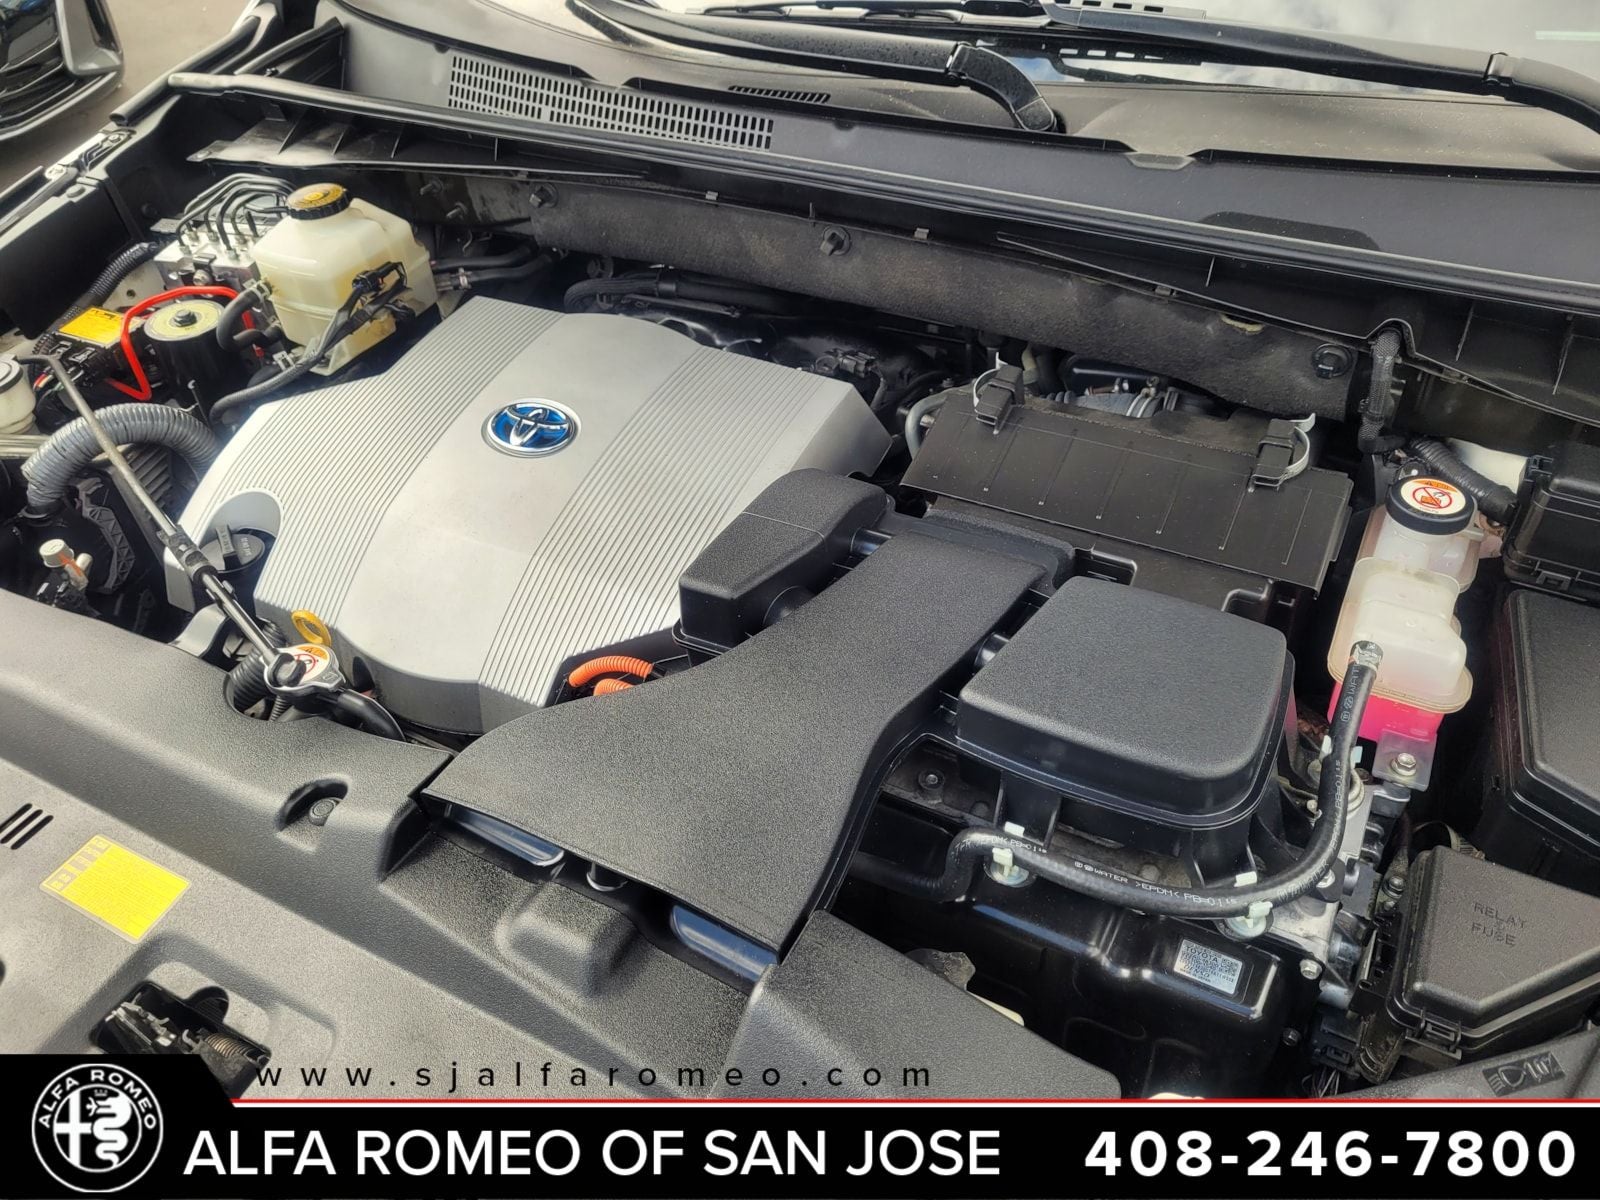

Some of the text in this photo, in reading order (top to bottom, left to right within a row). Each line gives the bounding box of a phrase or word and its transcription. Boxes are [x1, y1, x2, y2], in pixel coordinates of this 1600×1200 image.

[1094, 868, 1128, 883] WATER
[1474, 902, 1527, 929] RELAY
[1472, 922, 1516, 946] FUSE
[1185, 945, 1218, 962] TOYOTA
